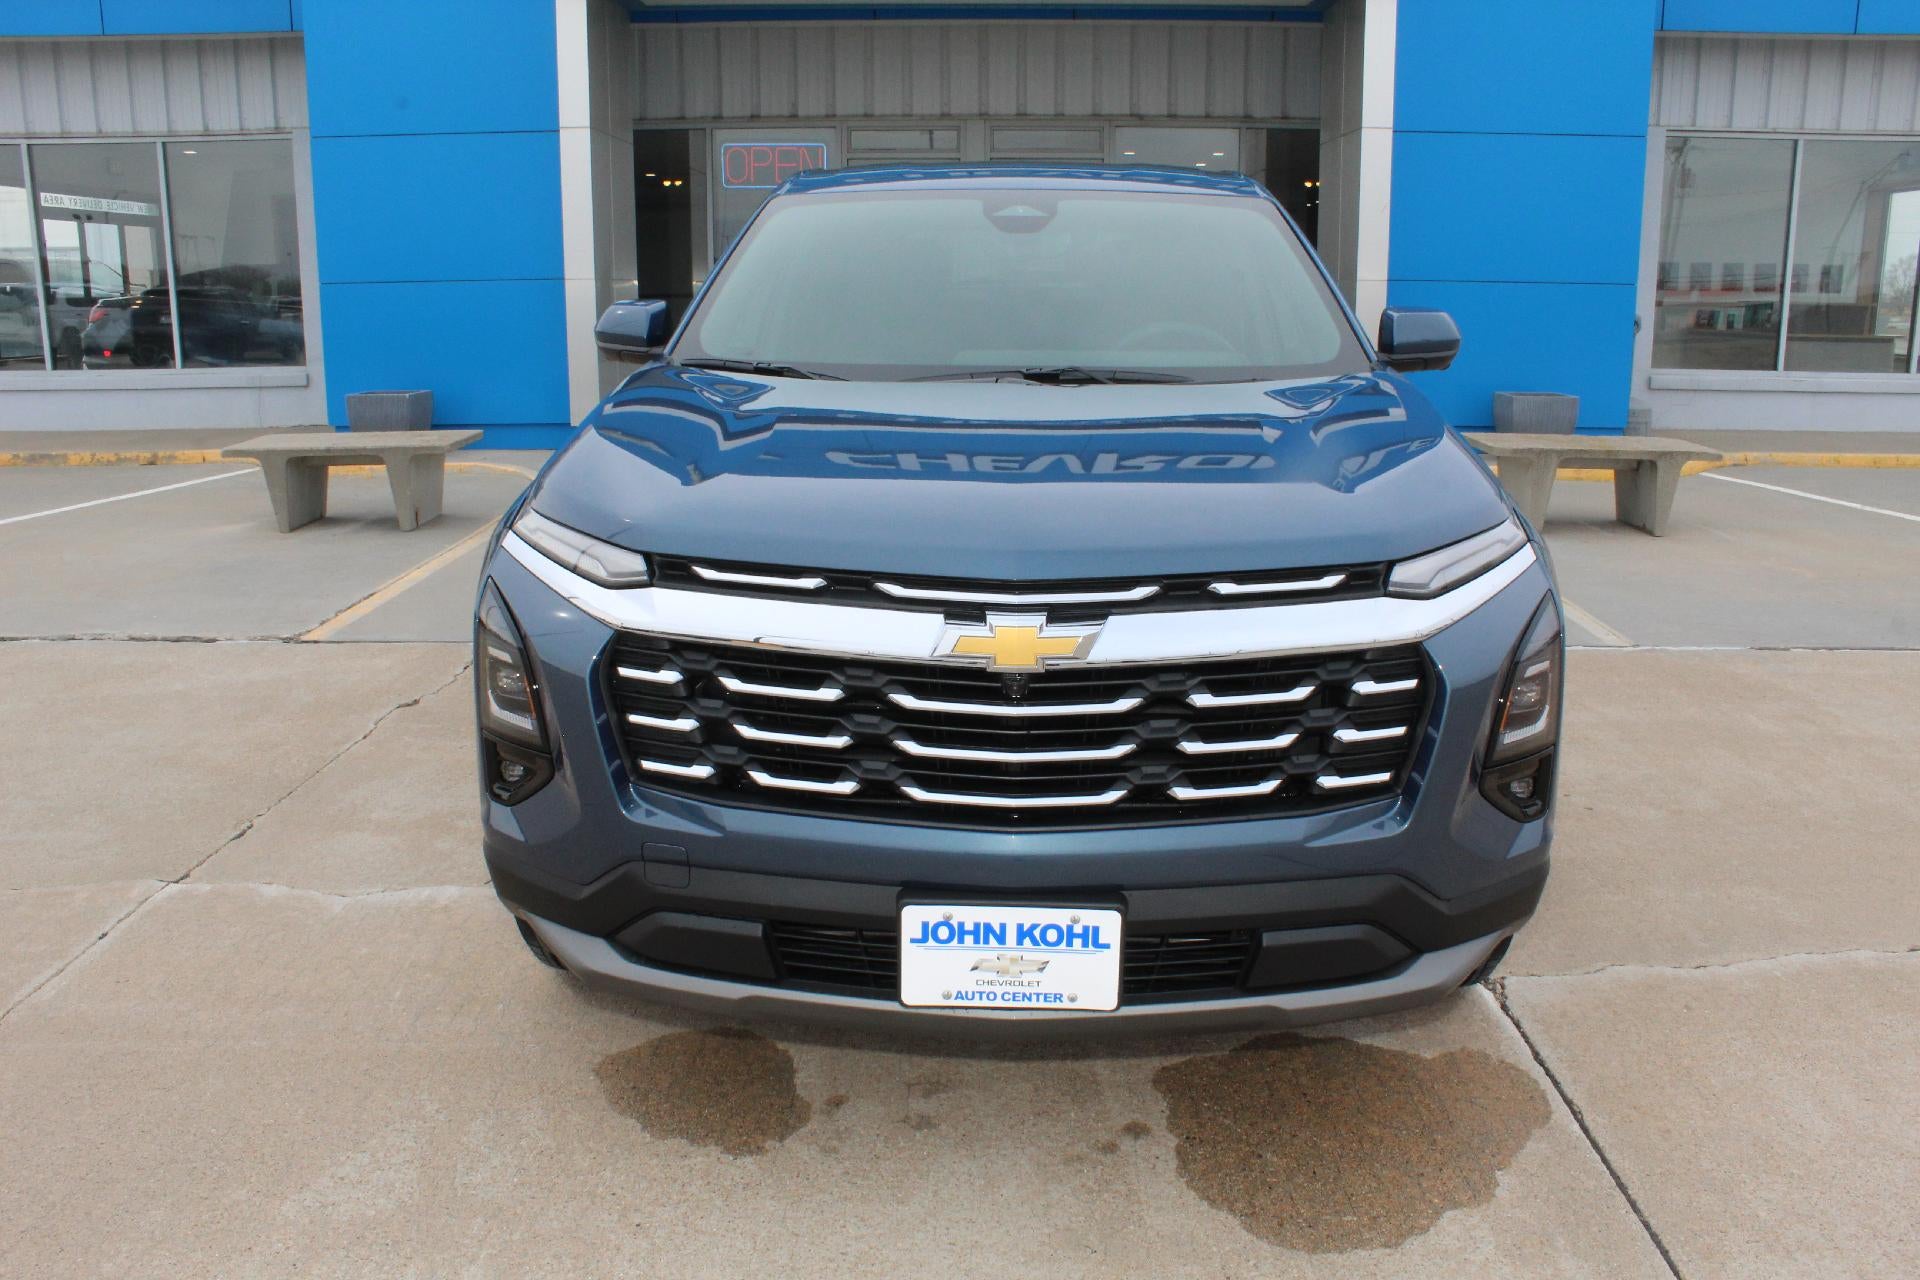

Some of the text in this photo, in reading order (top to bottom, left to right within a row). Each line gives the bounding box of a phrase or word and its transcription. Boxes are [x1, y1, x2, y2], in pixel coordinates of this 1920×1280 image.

[725, 146, 823, 184] OPEN
[909, 920, 1111, 950] JOHN KOHL
[975, 979, 1042, 988] CHEVROLET
[954, 990, 1064, 1004] AUTO CENTER
